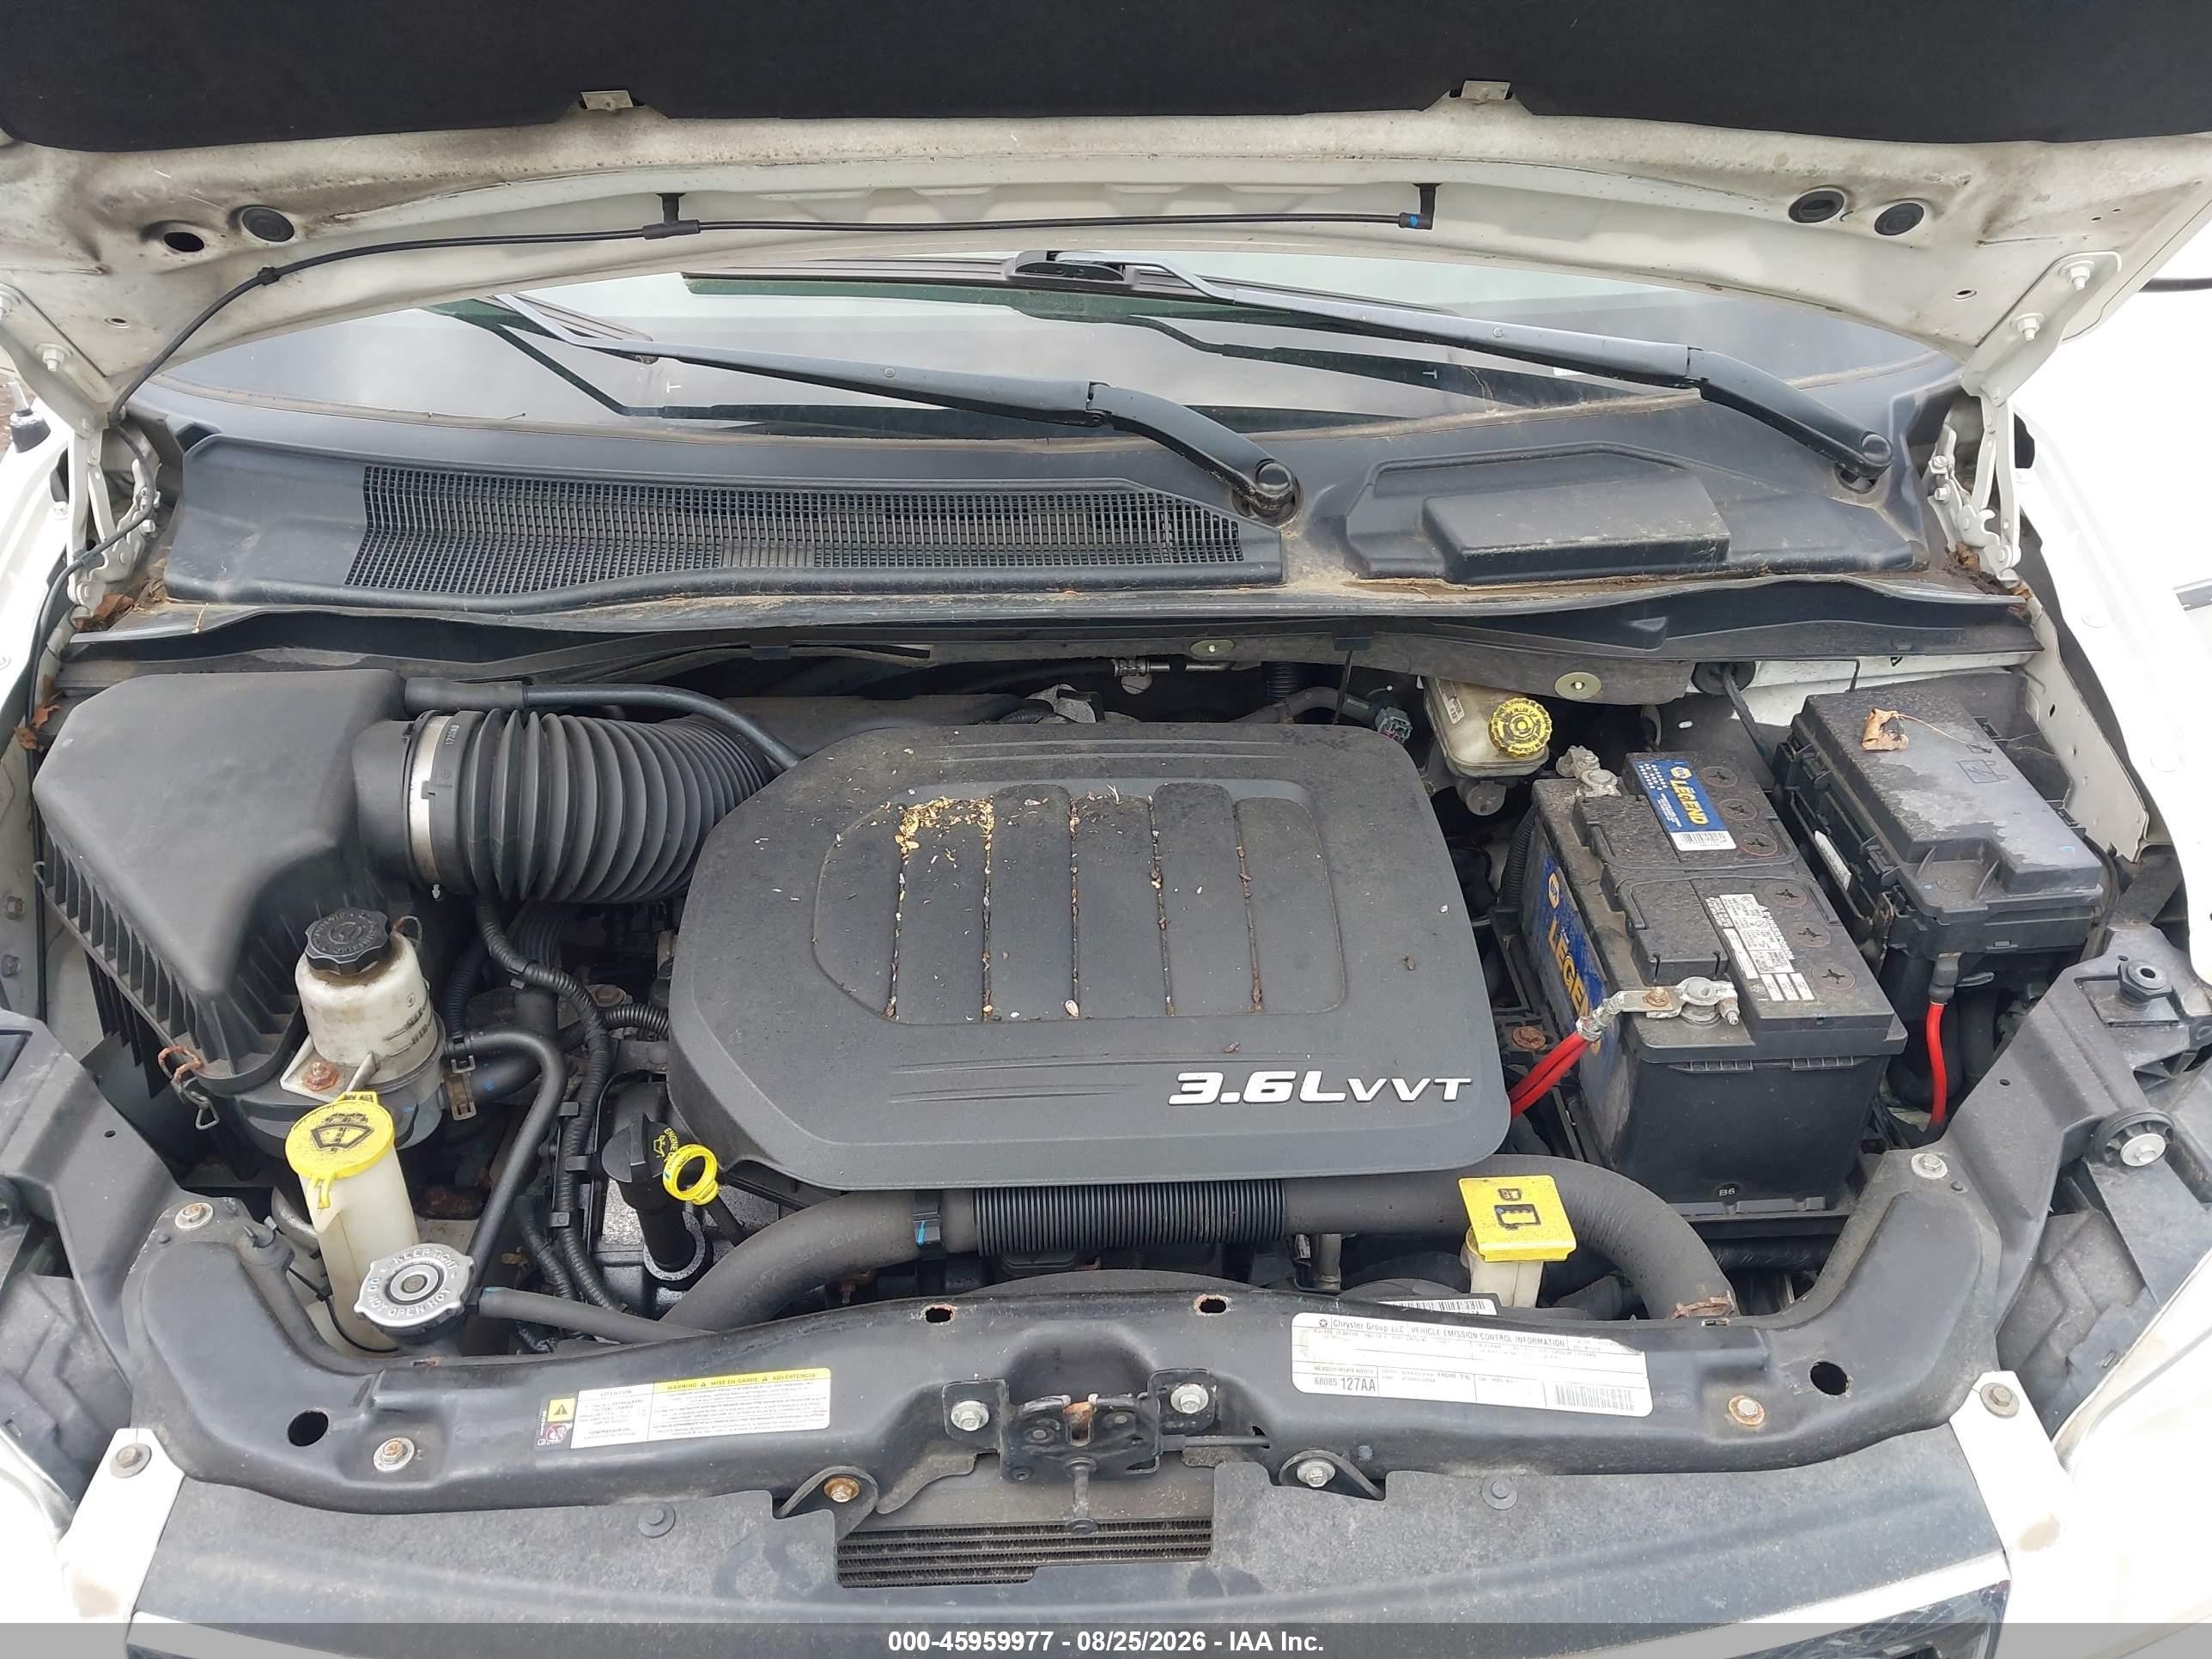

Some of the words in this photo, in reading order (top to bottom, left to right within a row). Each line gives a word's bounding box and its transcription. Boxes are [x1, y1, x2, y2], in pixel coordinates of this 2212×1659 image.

[1669, 780, 1709, 824] LEGEND
[663, 1127, 678, 1151] ENGINE
[392, 1249, 430, 1264] KEEP
[432, 1249, 459, 1270] TIGHT
[368, 1296, 388, 1312] NOT
[388, 1305, 426, 1317] OPEN
[428, 1288, 452, 1308] HOT
[1333, 1319, 1364, 1330] Chrysler
[1366, 1322, 1389, 1332] Group
[1391, 1325, 1405, 1334] LLC
[1411, 1327, 1441, 1336] VEHICLE
[1443, 1329, 1478, 1340] EMISSION
[1480, 1333, 1513, 1343] CONTROL
[1515, 1335, 1565, 1347] INFORMATION
[1315, 1376, 1338, 1387] 68085
[1341, 1376, 1376, 1391] 127AA
